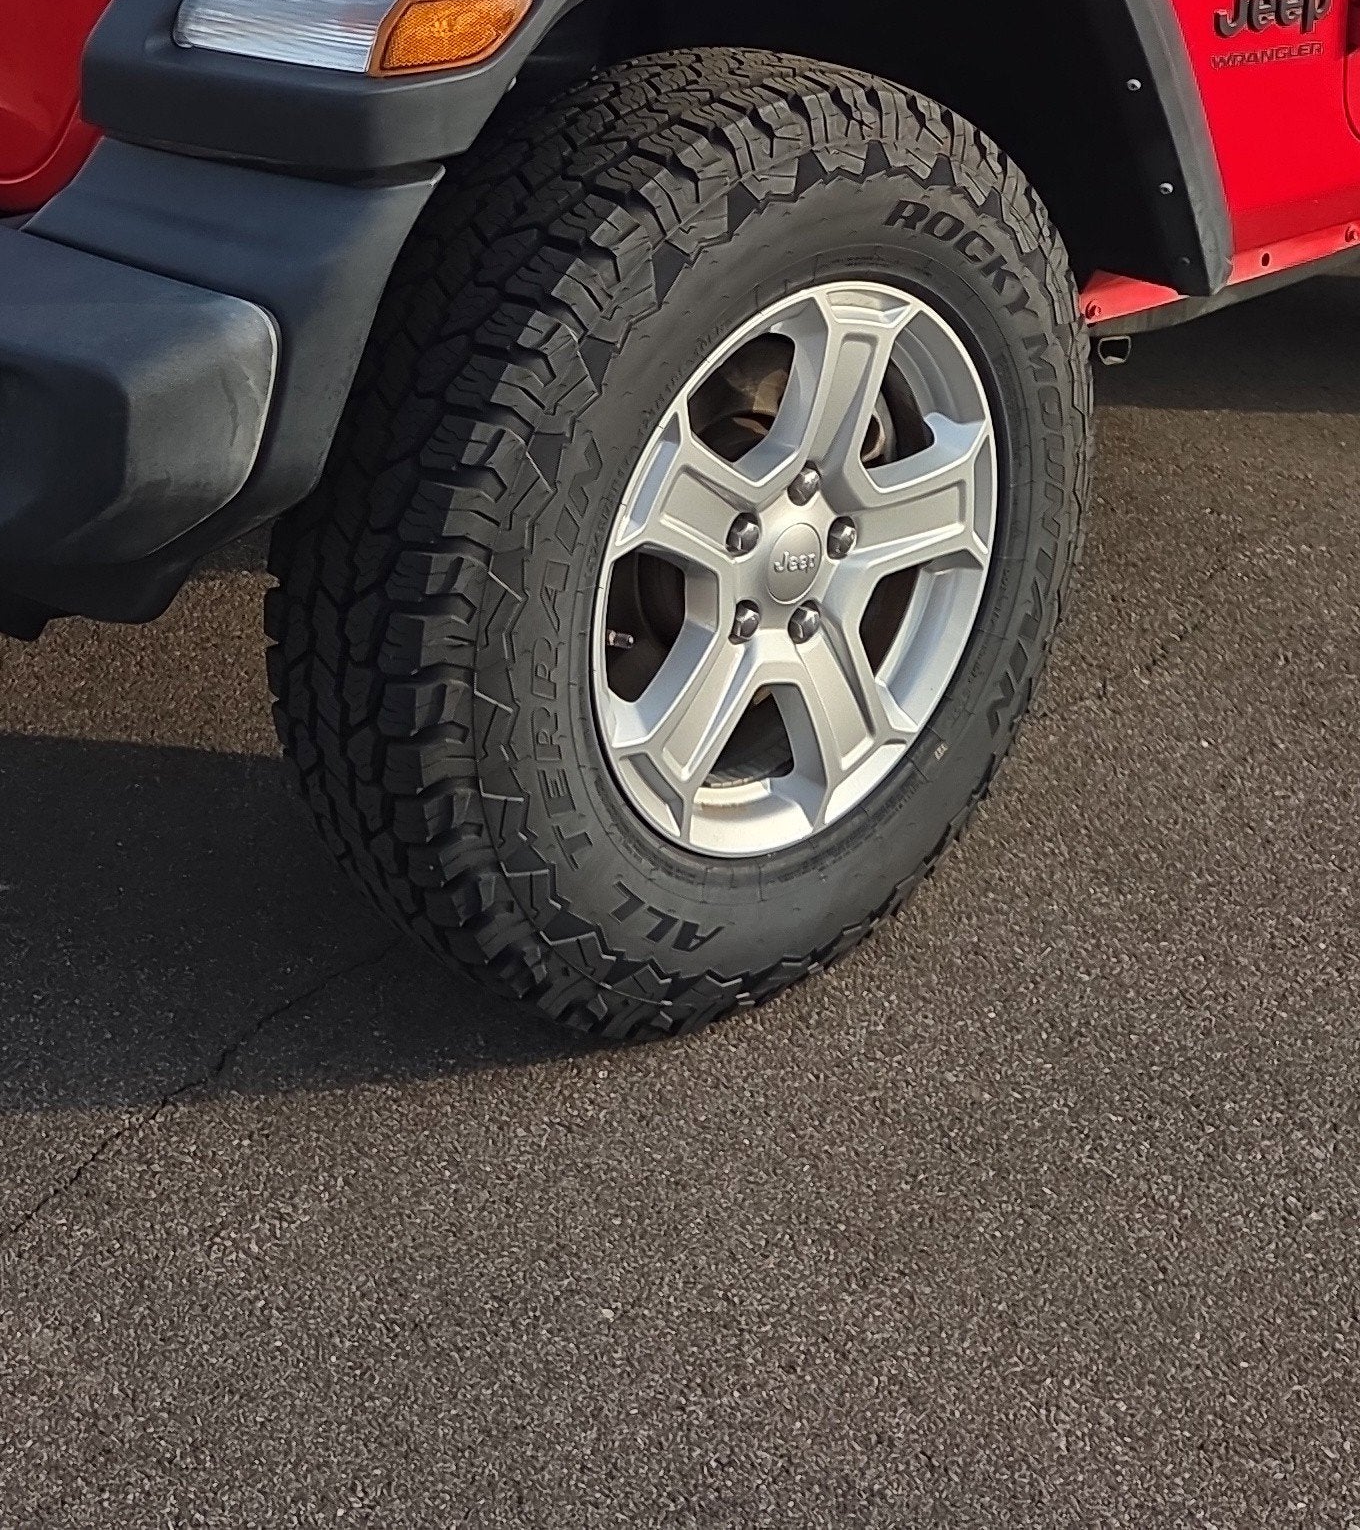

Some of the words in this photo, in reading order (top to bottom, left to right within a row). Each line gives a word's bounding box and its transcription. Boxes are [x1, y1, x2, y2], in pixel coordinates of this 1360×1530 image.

[1210, 41, 1324, 70] WRANGLER
[884, 198, 1040, 319] ROCKY
[530, 434, 603, 871] TERRAIN
[610, 880, 724, 952] ALL
